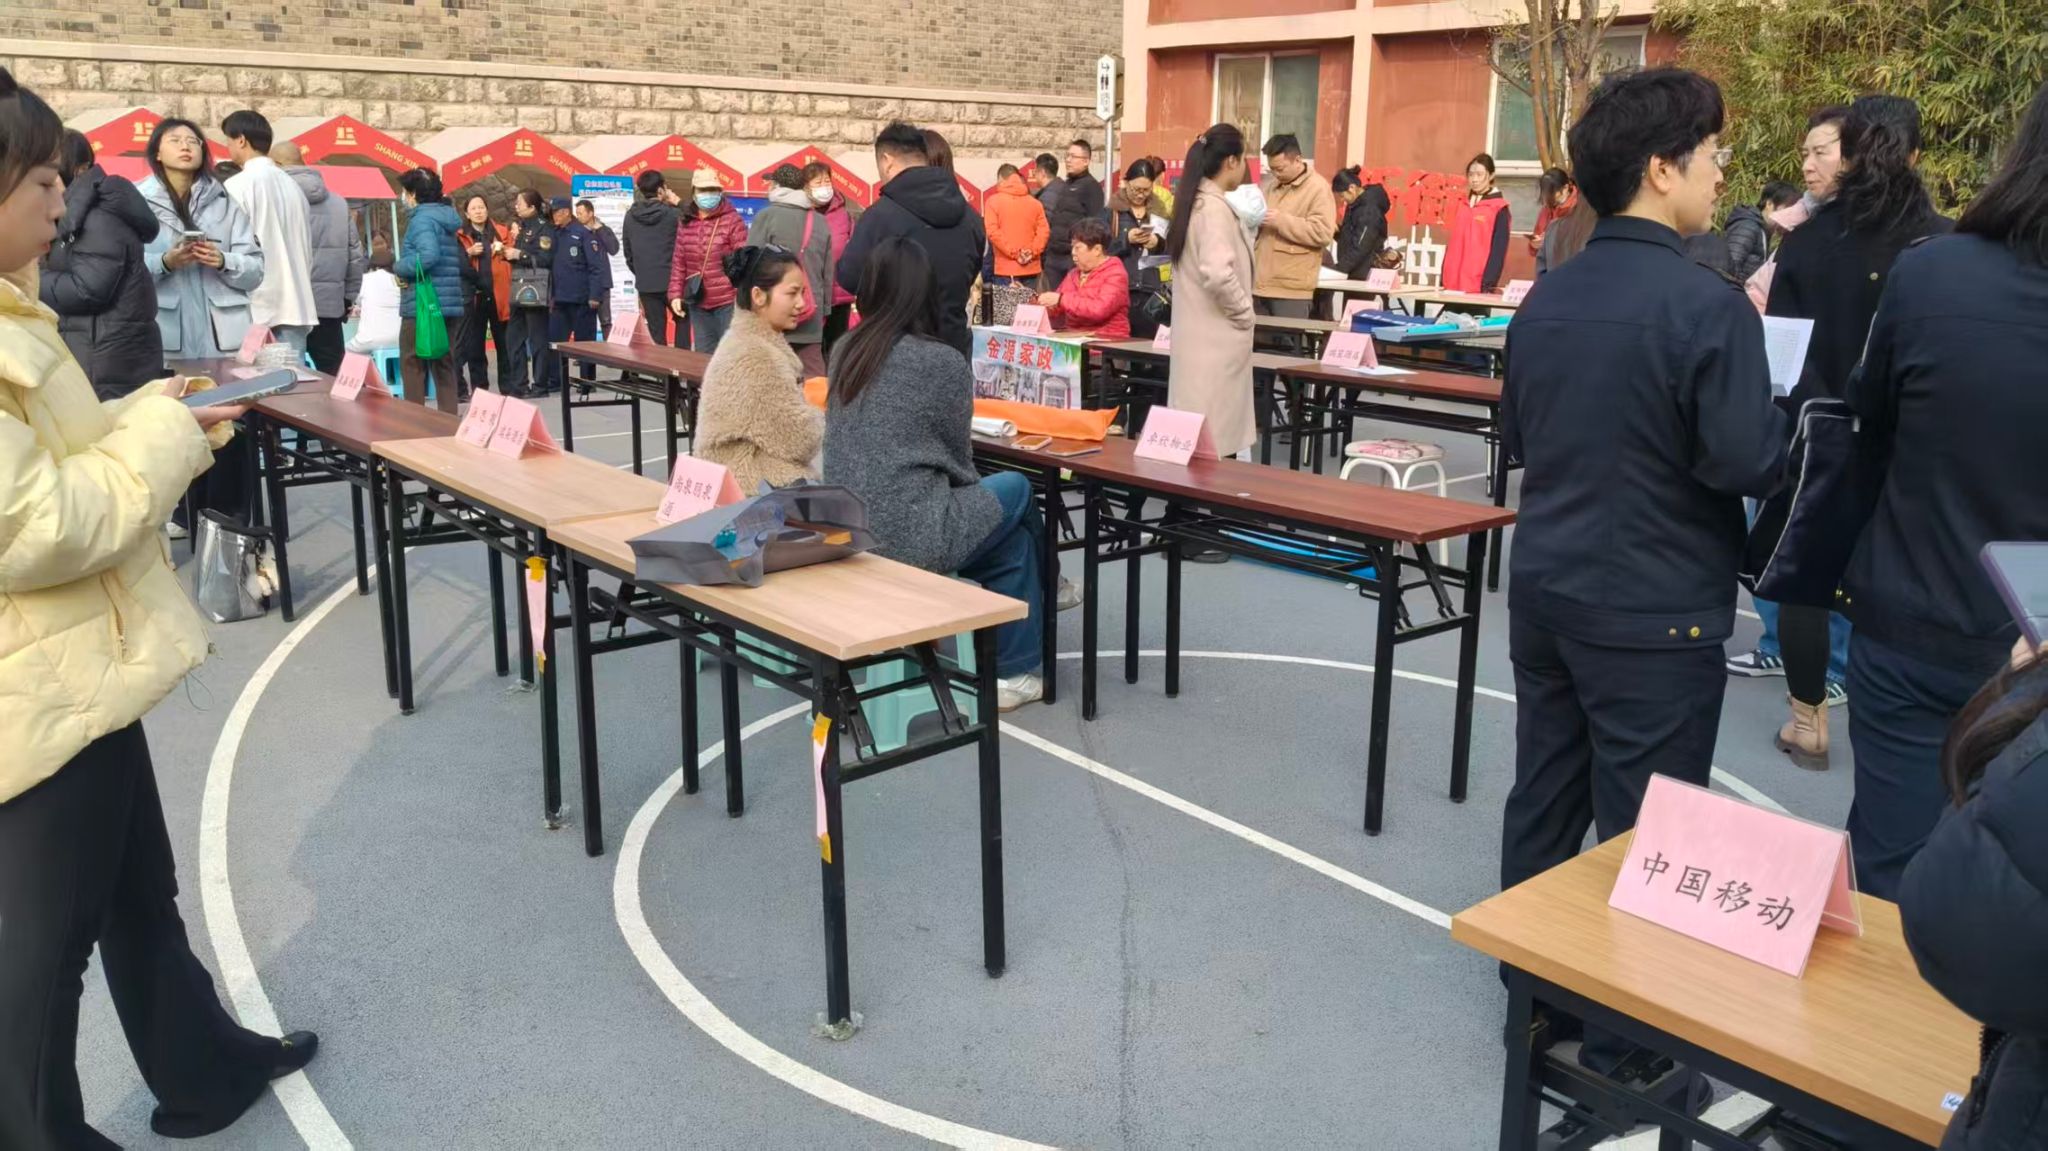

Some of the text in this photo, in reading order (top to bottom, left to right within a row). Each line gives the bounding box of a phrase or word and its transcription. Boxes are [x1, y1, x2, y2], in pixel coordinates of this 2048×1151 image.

[986, 336, 1054, 371] 金源家政
[1643, 852, 1795, 930] 中国移动
